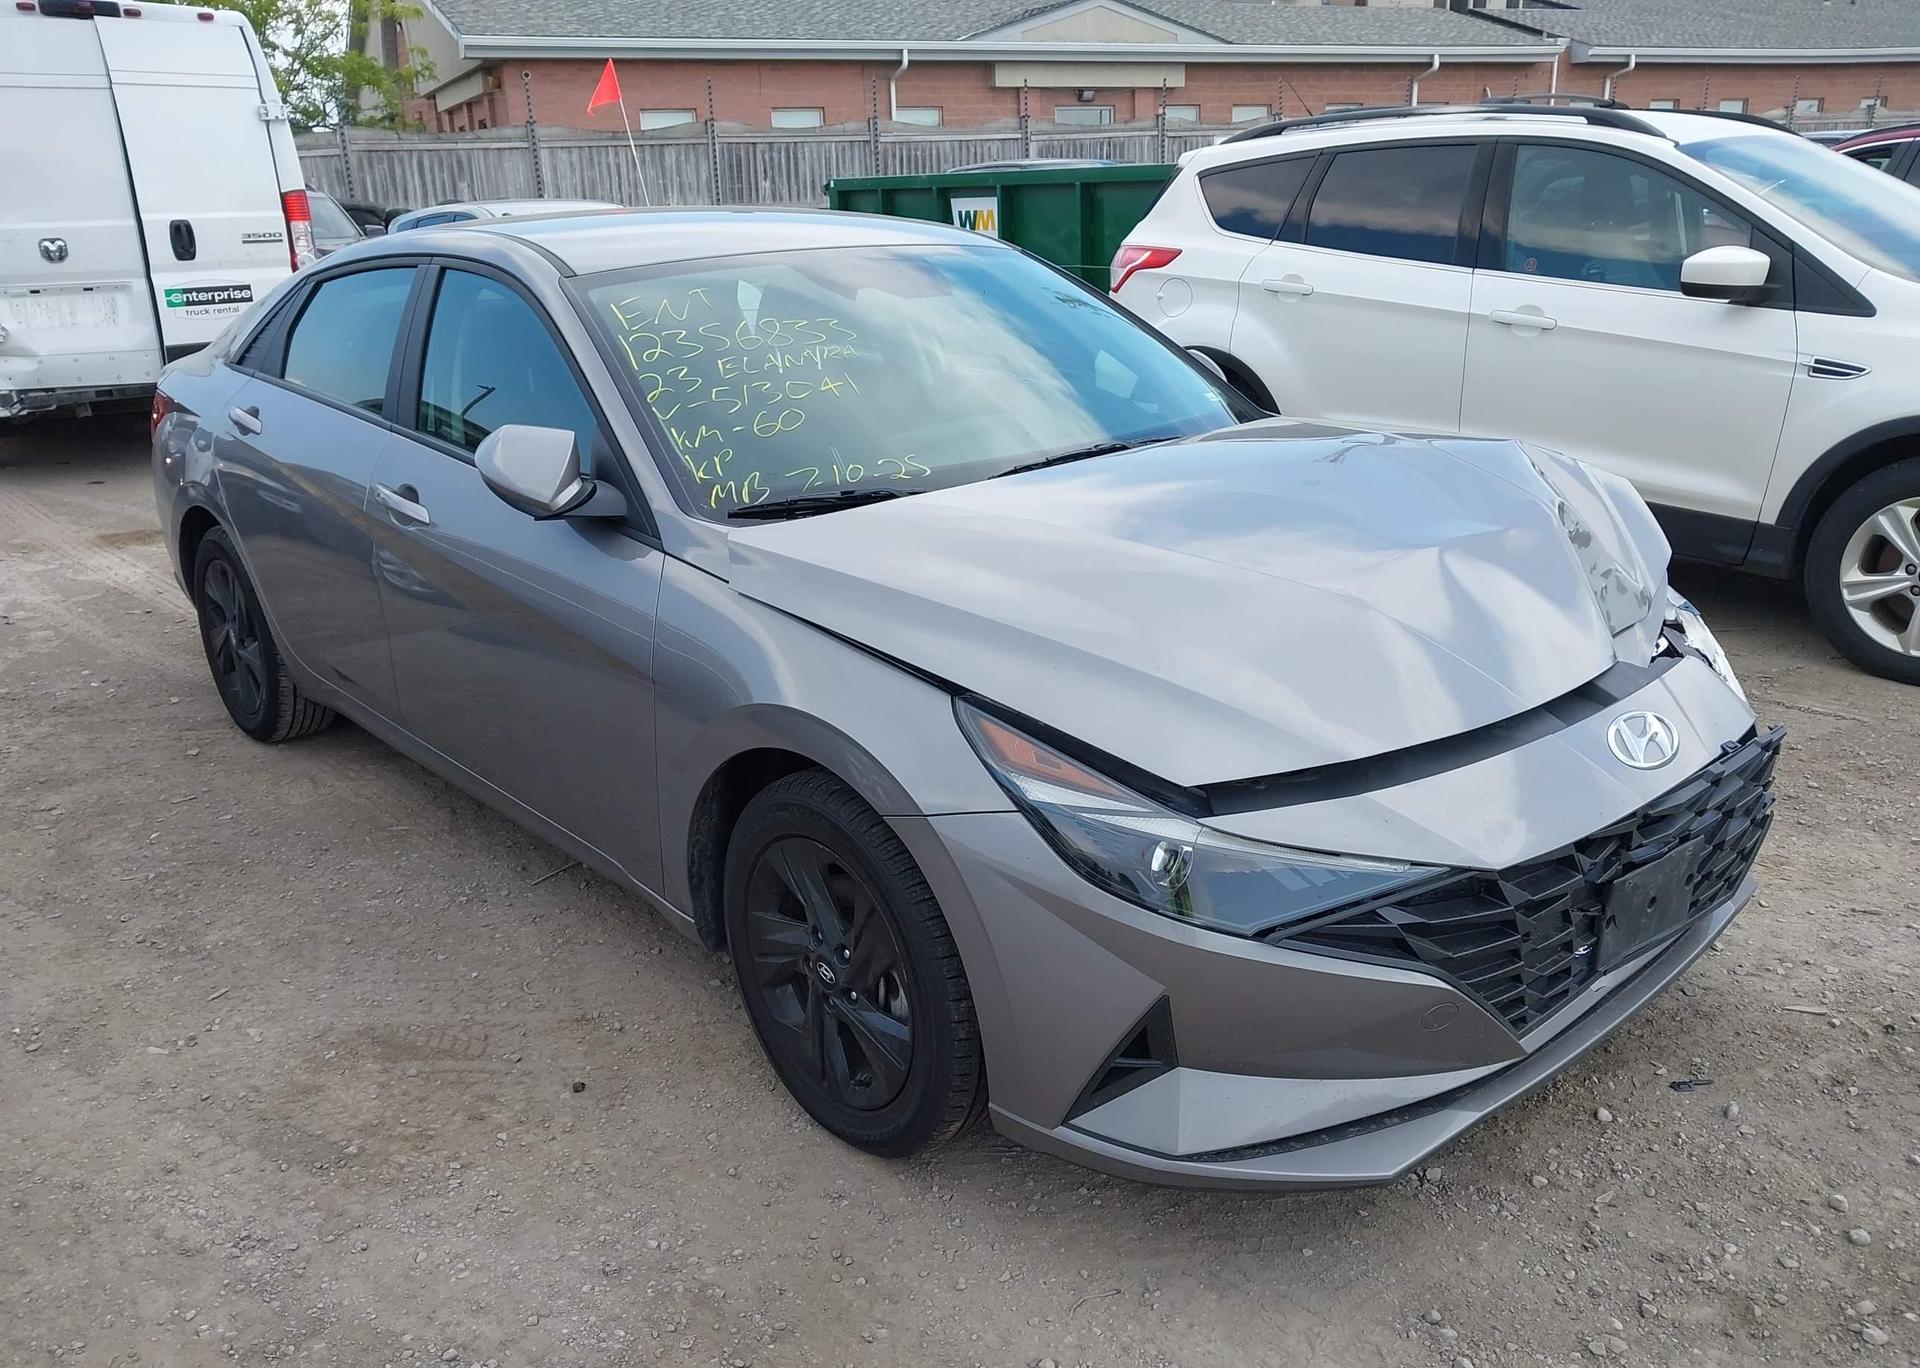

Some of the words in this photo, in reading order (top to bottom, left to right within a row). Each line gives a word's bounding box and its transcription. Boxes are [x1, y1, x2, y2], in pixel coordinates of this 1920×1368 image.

[957, 209, 996, 231] WM
[241, 231, 283, 239] 3500
[166, 287, 251, 304] enterprise
[185, 307, 210, 316] truck
[212, 305, 240, 314] rental
[610, 287, 714, 331] ENT
[618, 317, 857, 370] 12356833
[638, 365, 702, 403] 23
